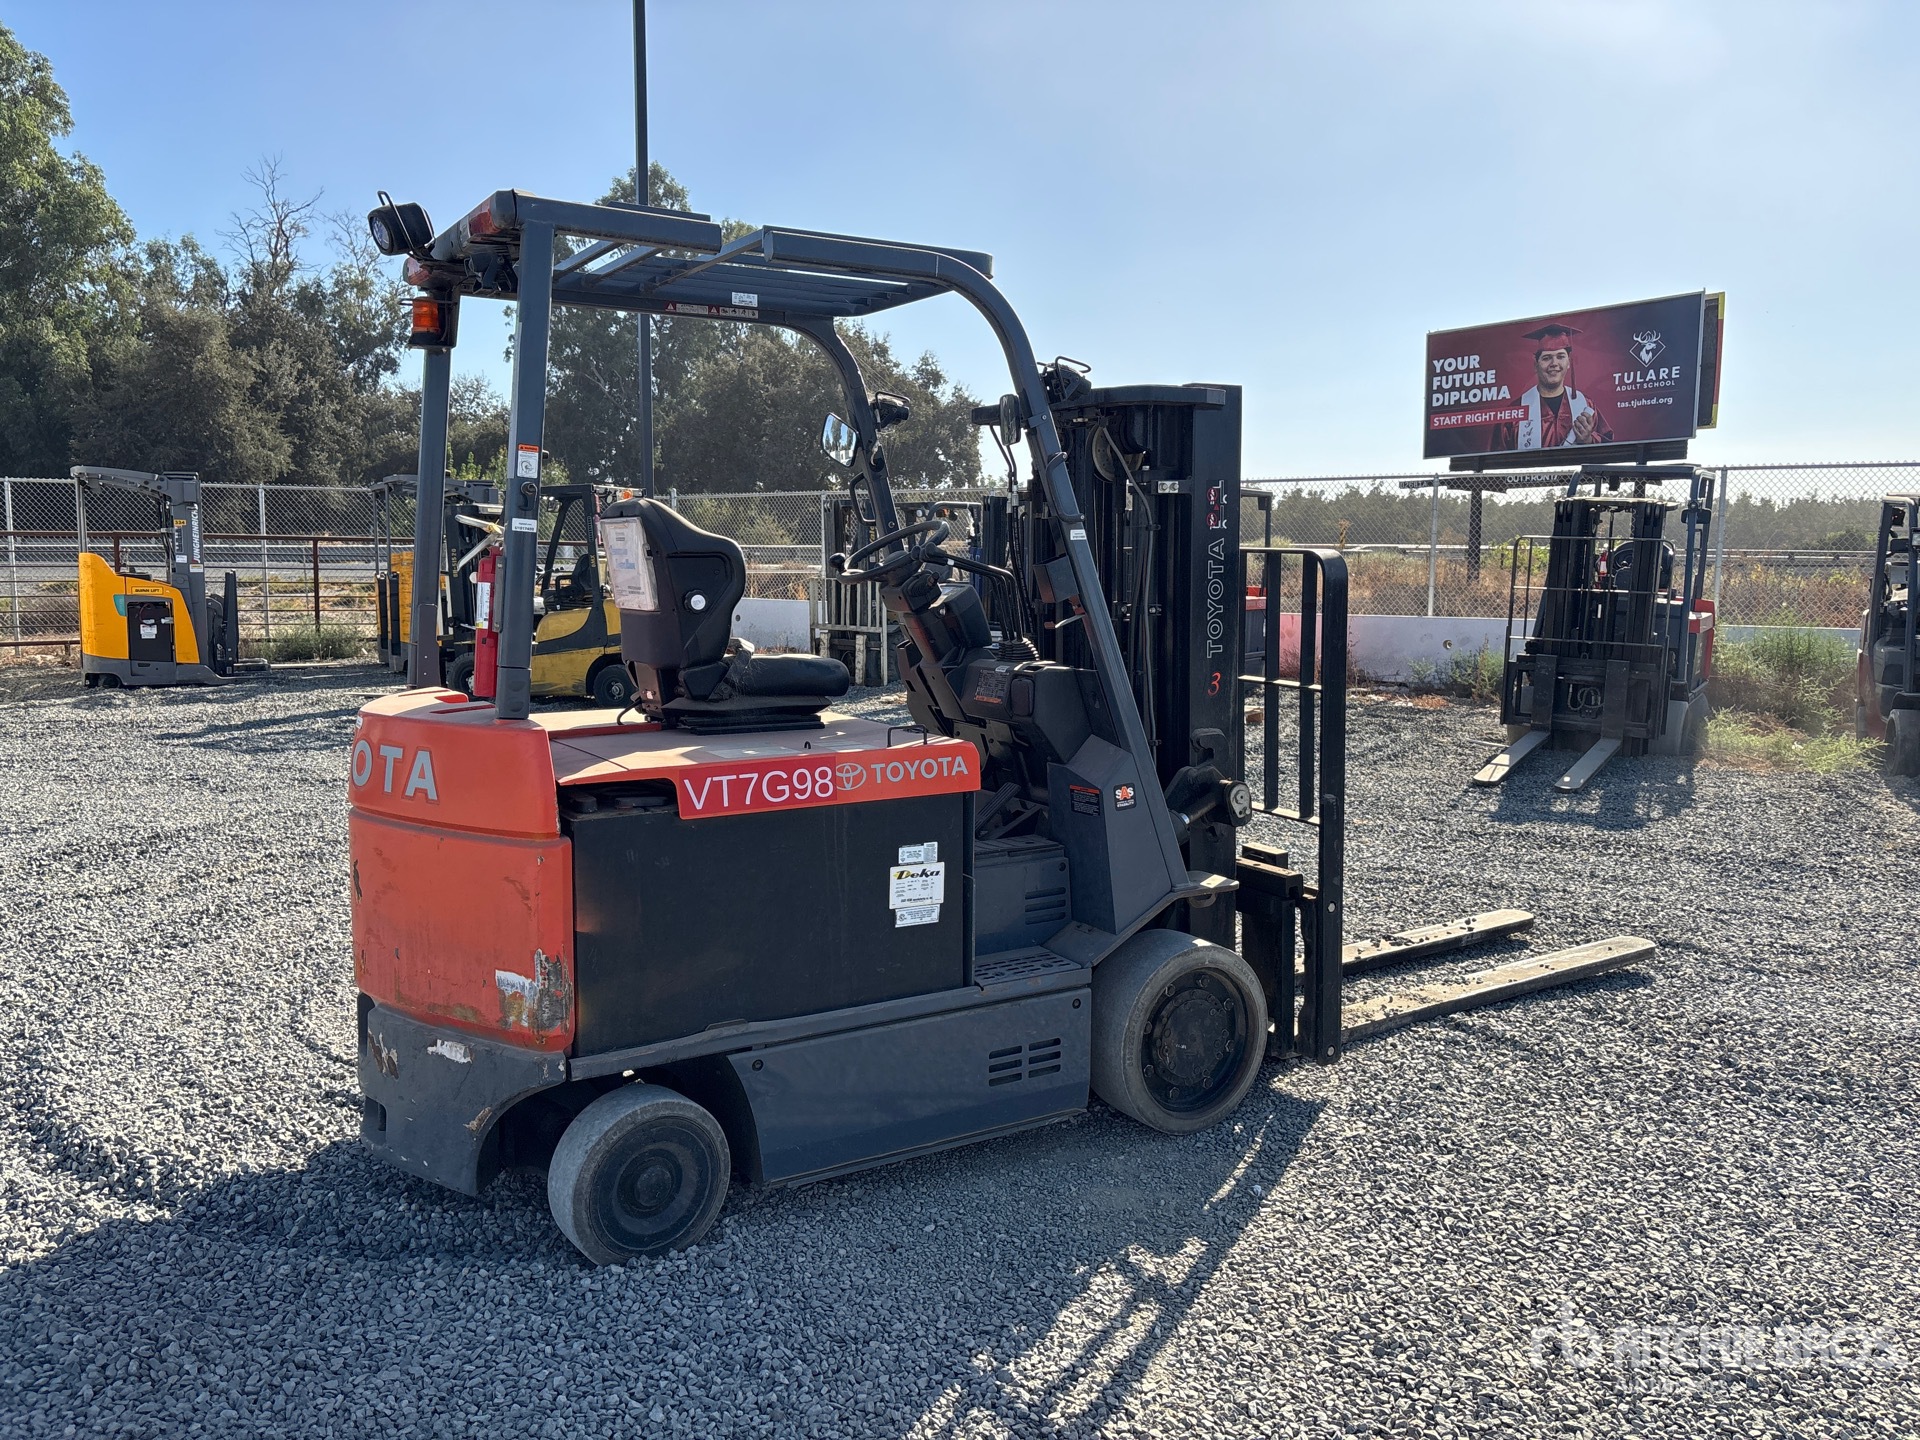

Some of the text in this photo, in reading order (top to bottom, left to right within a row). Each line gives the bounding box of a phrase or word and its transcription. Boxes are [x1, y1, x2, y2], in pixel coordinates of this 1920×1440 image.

[1432, 354, 1480, 373] YOUR
[1432, 369, 1496, 390] FUTURE
[1613, 366, 1680, 385] TULARE
[1616, 380, 1675, 392] ADULT SCHOOL
[1432, 385, 1511, 407] DIPLOMA
[1617, 397, 1673, 408] tas.tjuhsd.org
[1433, 408, 1524, 426] START RIGHT HERE
[192, 507, 200, 563] JUNGHEINRICH
[1207, 538, 1224, 658] TOYOTA
[1207, 671, 1221, 696] 3
[684, 755, 968, 811] VT7G98 TOYOTA
[1115, 786, 1134, 801] SAS
[896, 868, 941, 880] Deka
